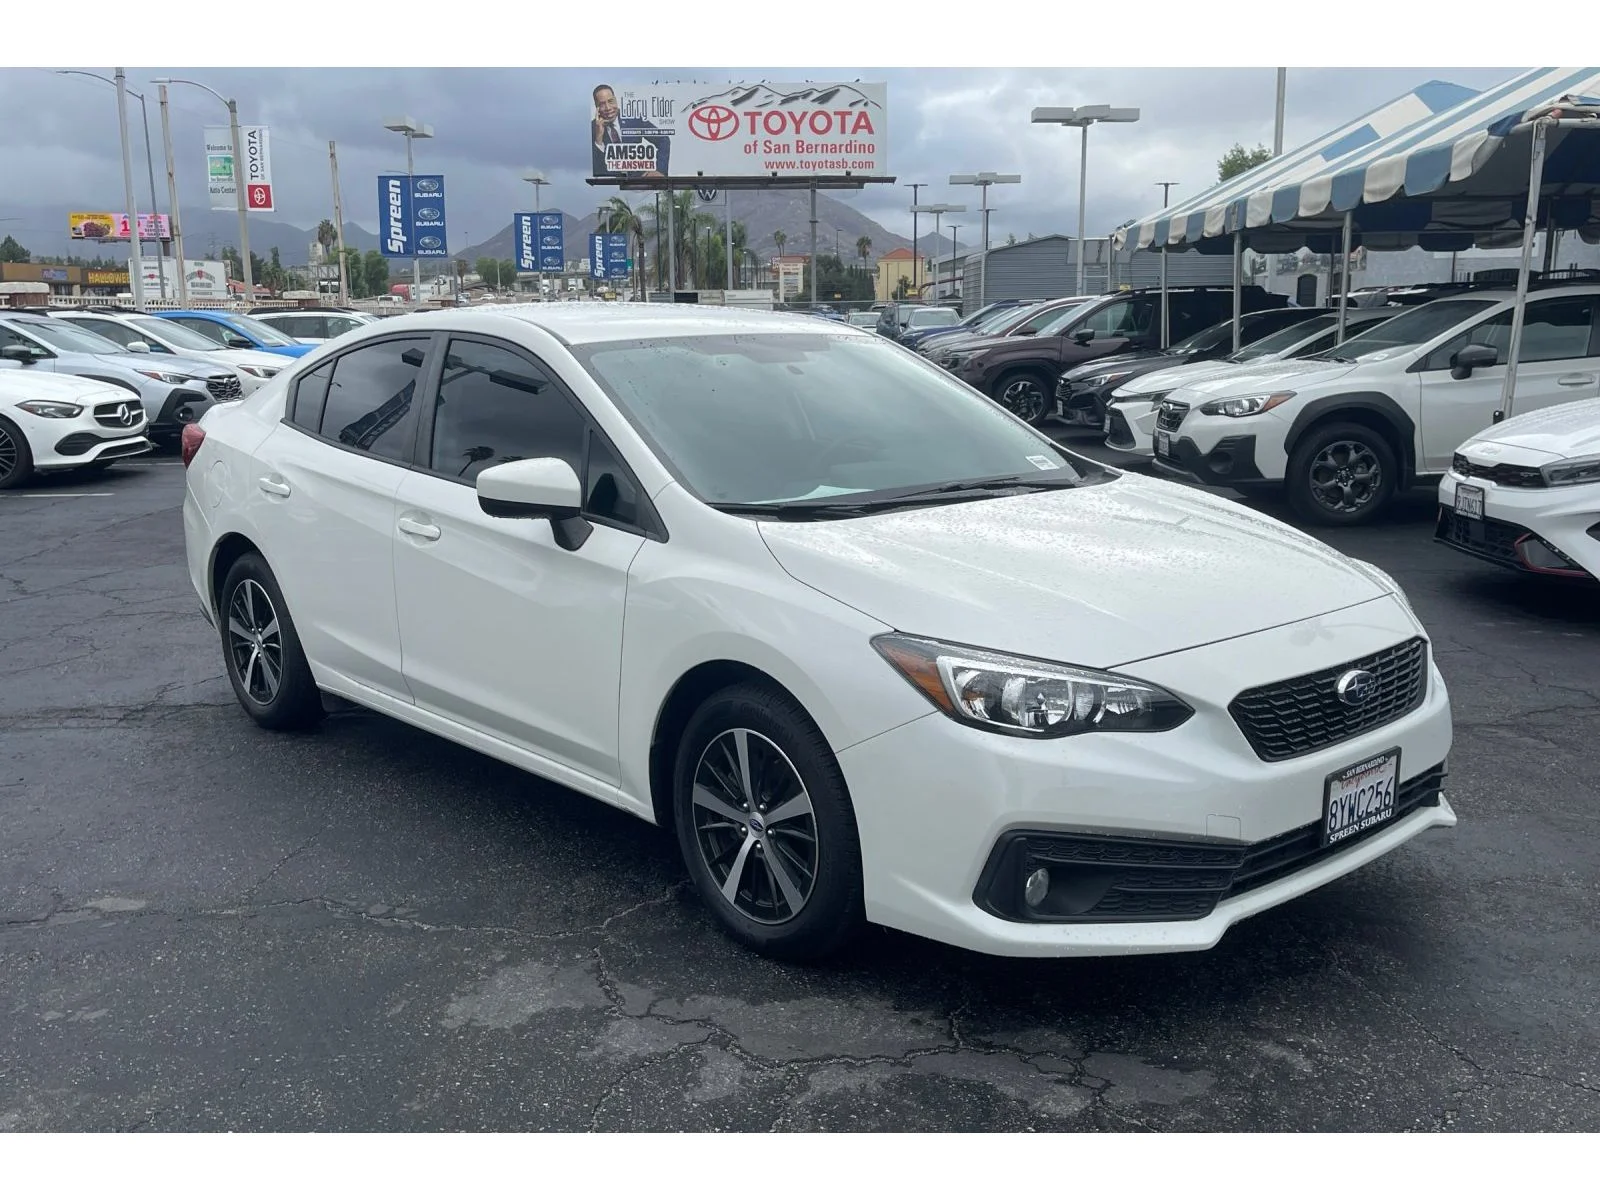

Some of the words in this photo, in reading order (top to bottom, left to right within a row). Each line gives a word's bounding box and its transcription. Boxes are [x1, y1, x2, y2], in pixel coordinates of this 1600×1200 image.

[620, 96, 648, 121] Larry
[651, 96, 676, 118] Elder
[743, 110, 875, 135] TOYOTA
[247, 130, 259, 181] TOYOTA
[607, 161, 621, 169] THE
[621, 161, 655, 169] ANSWER
[743, 140, 758, 154] of
[763, 140, 790, 154] San
[795, 140, 875, 154] Bernardino
[764, 158, 875, 171] www.toyotasb.com
[387, 179, 407, 254] Spreen
[520, 215, 535, 270] Spreen
[594, 235, 606, 278] Spreen
[1328, 775, 1394, 832] 8YWC256
[1329, 823, 1360, 844] SPREEN
[1360, 808, 1392, 830] SUBARU
